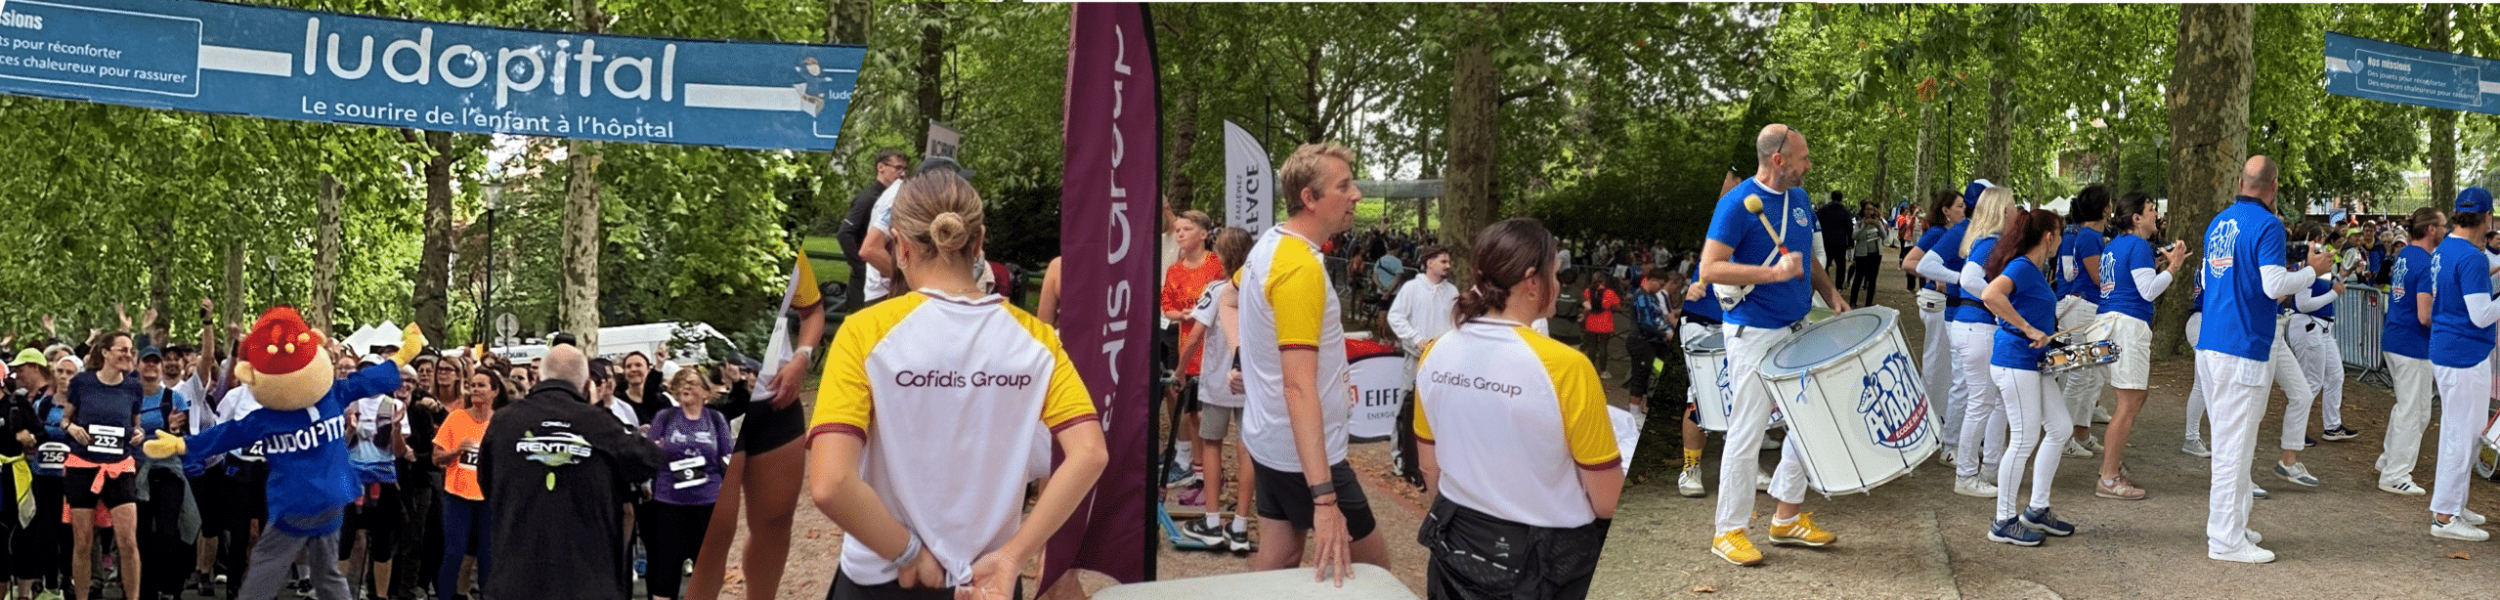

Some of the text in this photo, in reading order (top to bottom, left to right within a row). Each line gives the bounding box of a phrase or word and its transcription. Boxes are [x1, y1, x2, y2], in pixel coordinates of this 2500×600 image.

[0, 9, 43, 30] sions
[13, 38, 45, 50] pour
[48, 41, 122, 59] réconforter
[23, 55, 96, 73] chaleureux
[99, 65, 131, 77] pour
[134, 69, 188, 83] rassurer
[304, 17, 677, 108] ludopital
[2367, 56, 2411, 72] Nos missions
[2367, 69, 2379, 78] Des
[2399, 75, 2413, 84] pour
[2367, 78, 2379, 86] Des
[2380, 81, 2403, 92] espaces
[2404, 83, 2436, 95] chaleureux
[2437, 88, 2451, 98] pour
[302, 95, 673, 139] Le sourire de l'enfant à l'hôpital
[895, 370, 1032, 390] Cofidis Group
[1431, 371, 1522, 398] Cofidis Group
[95, 435, 118, 447] 232
[516, 442, 592, 457] RENTIES
[42, 452, 65, 462] 256
[684, 468, 694, 480] 9
